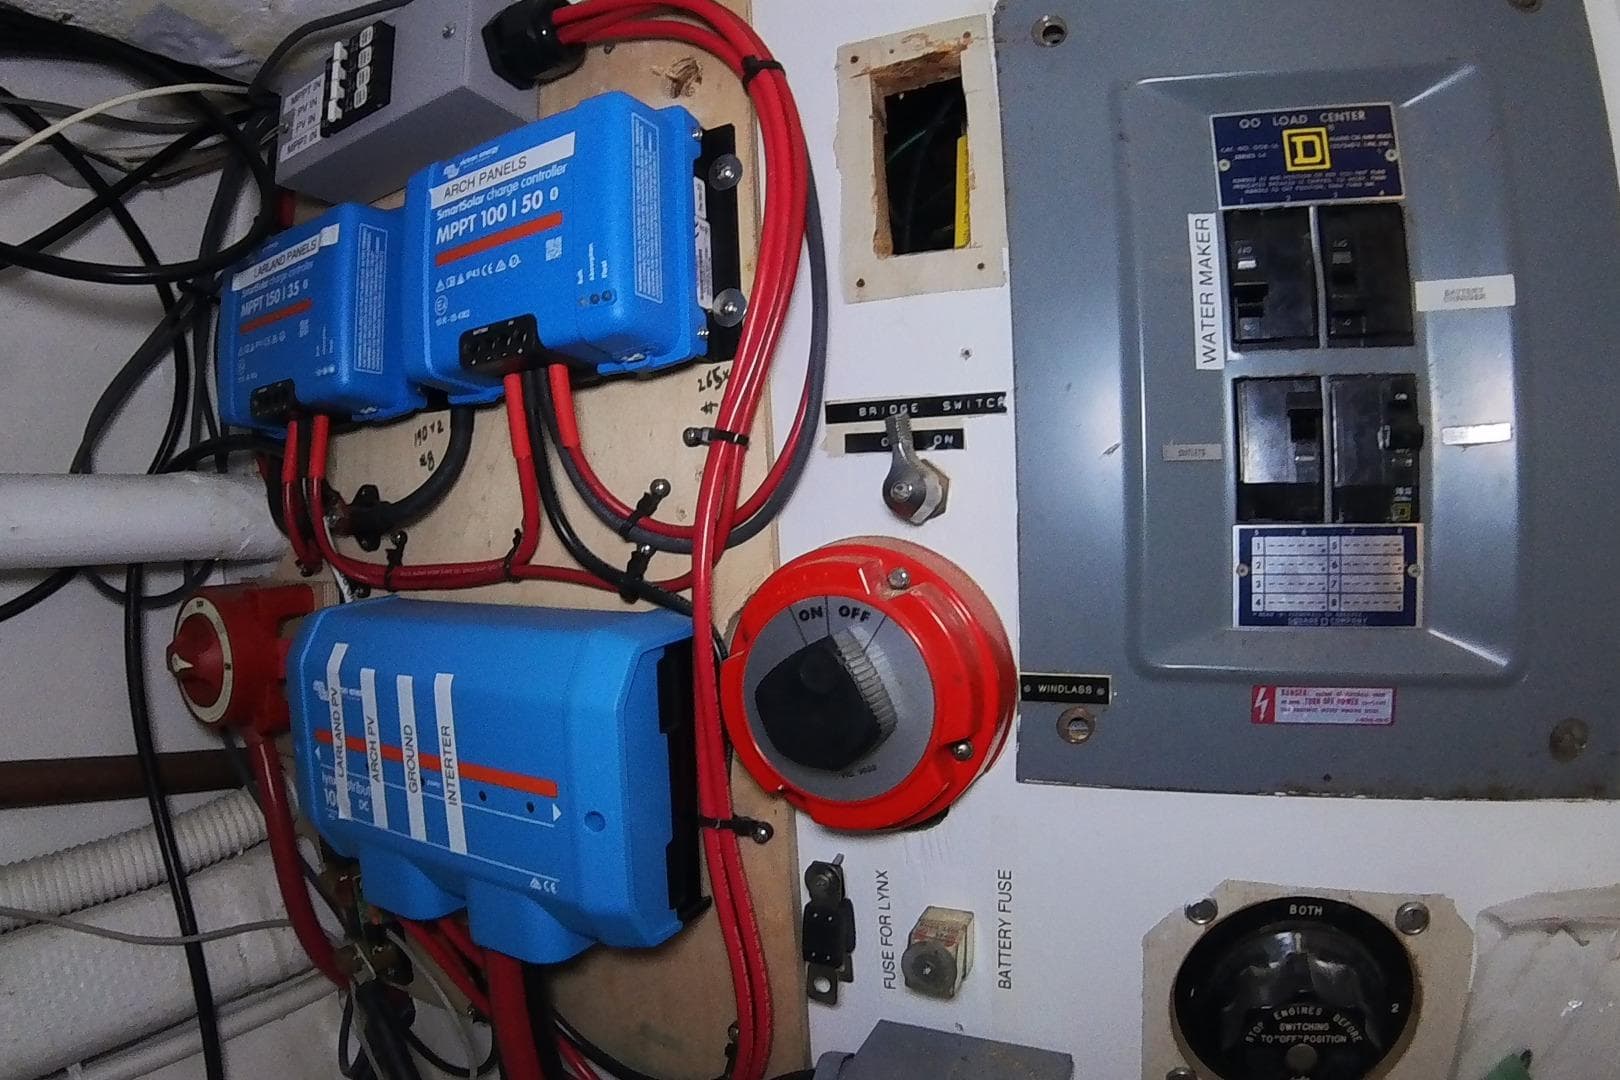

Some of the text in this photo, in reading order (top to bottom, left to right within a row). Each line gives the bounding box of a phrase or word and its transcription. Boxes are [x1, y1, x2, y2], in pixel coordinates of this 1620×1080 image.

[1272, 114, 1309, 127] LOAD
[1319, 110, 1367, 123] CENTER
[443, 156, 528, 201] ARCH PANELS
[436, 162, 569, 222] SmartSolar charge controller
[435, 216, 477, 246] MPPT
[480, 205, 508, 230] 100
[520, 190, 544, 216] 50
[286, 279, 300, 299] 35
[1194, 215, 1217, 365] WATER MAKER
[858, 402, 920, 417] BRIDGE
[933, 434, 954, 445] ON
[799, 605, 871, 622] ON OFF
[329, 687, 343, 711] PV
[1038, 683, 1092, 696] WINDLASS
[366, 716, 381, 783] ARCH PV
[403, 723, 418, 795] GROUND
[440, 725, 459, 807] INTERTER
[1289, 904, 1323, 917] BOTH
[875, 869, 897, 990] FUSE FOR LYNX
[997, 869, 1012, 990] BATTERY FUSE
[1391, 1003, 1400, 1014] 2
[1273, 1006, 1323, 1021] ENGINES
[1332, 1014, 1363, 1043] BEFORE
[1279, 1022, 1330, 1032] SWITCHING
[1303, 1034, 1347, 1044] POSITION
